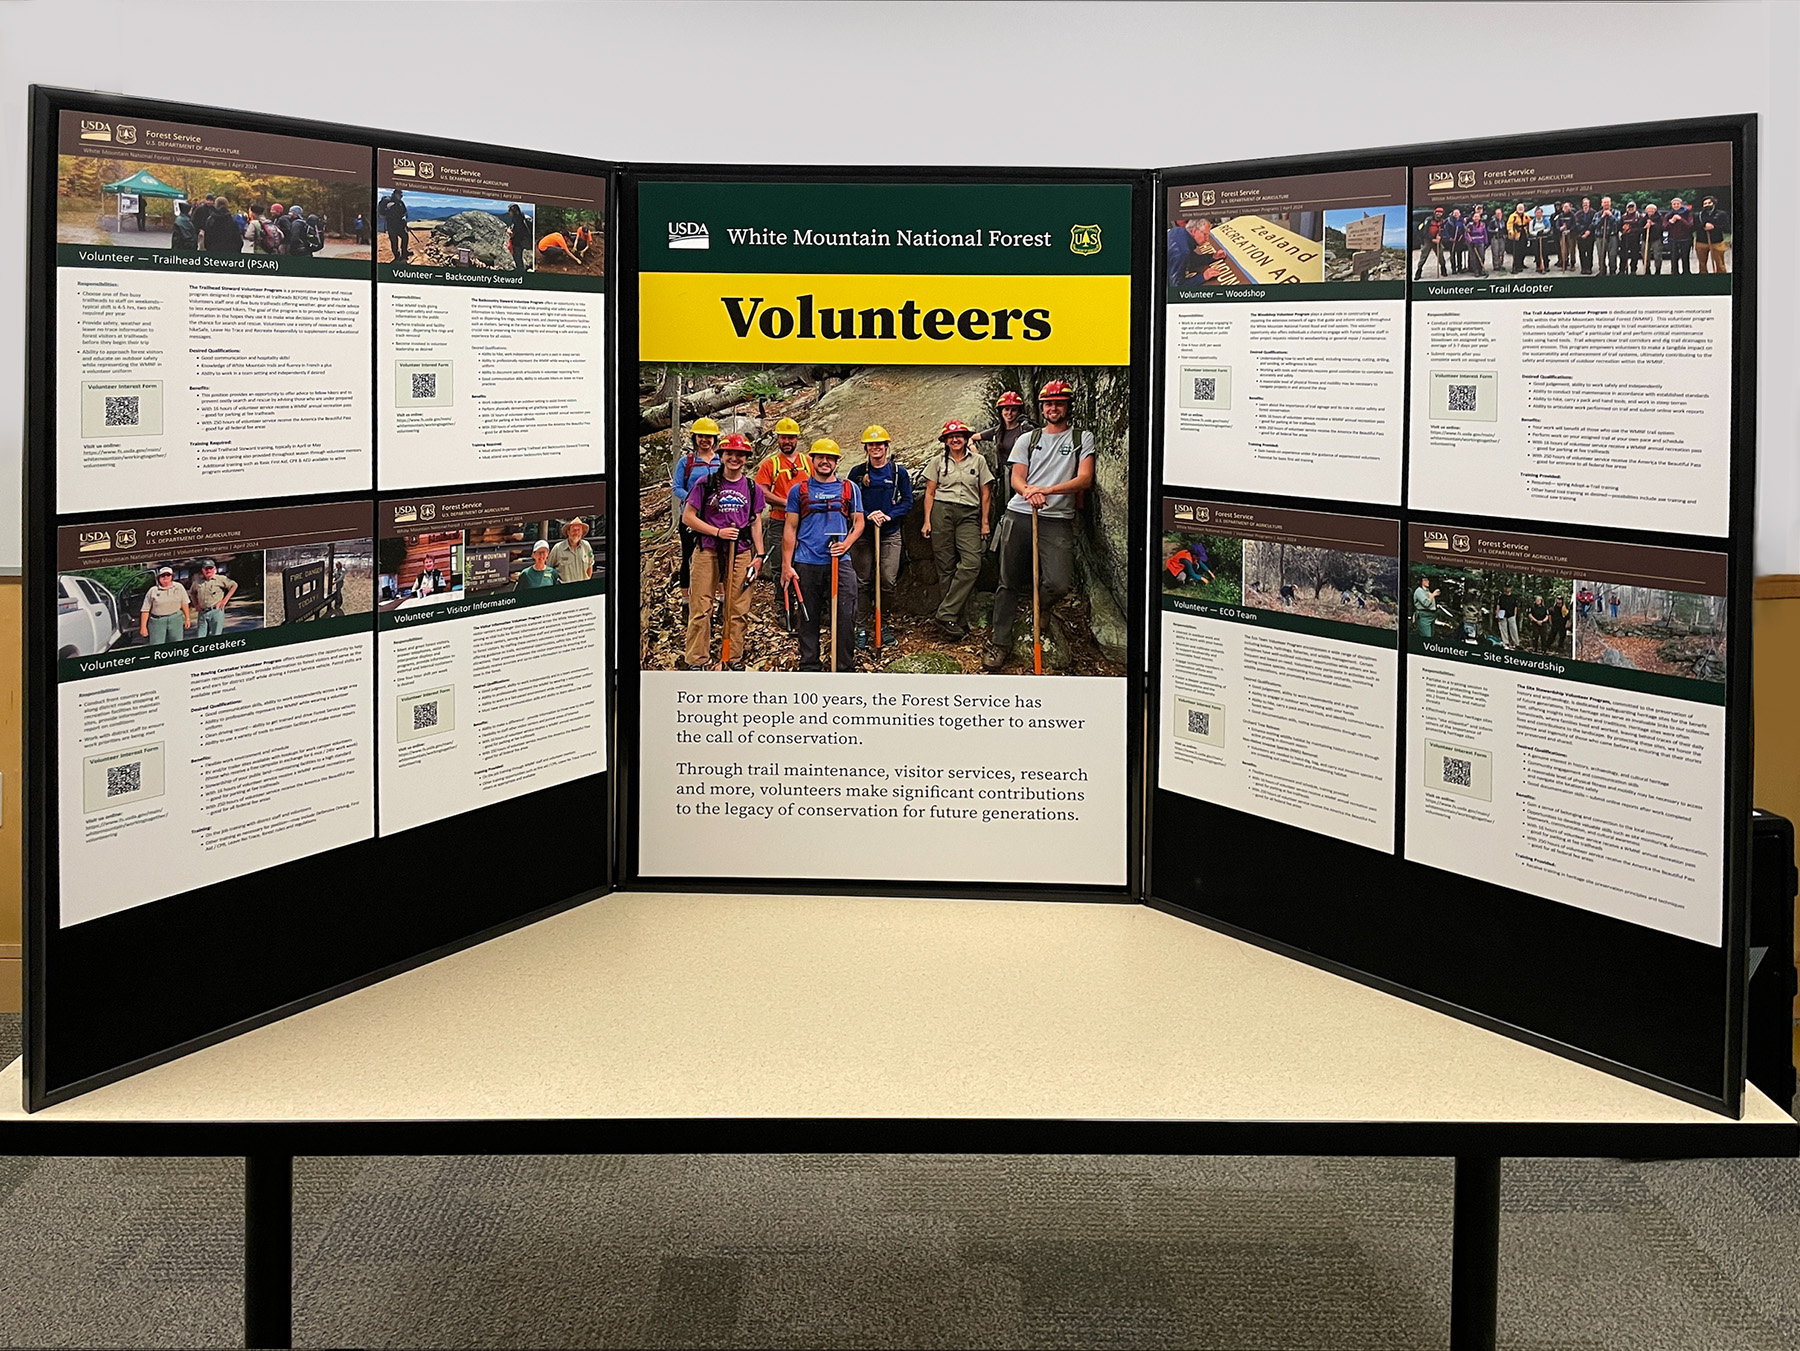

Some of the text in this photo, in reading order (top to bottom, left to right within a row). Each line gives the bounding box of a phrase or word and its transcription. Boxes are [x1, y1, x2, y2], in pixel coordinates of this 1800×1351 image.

[81, 120, 111, 131] USDA
[146, 130, 201, 143] Forest Service
[157, 140, 195, 149] DEPARTMENT
[203, 146, 240, 154] AGRICULTURE
[393, 157, 416, 168] USDA
[440, 166, 481, 177] Forest Service
[1429, 172, 1454, 180] USDA
[1483, 168, 1535, 178] Forest Service
[1494, 176, 1529, 184] DEPARTMENT
[1537, 173, 1574, 181] AGRICULTURE
[1180, 191, 1199, 200] USDA
[668, 221, 709, 236] USDA
[726, 227, 1052, 247] White Mountain National Forest
[1218, 224, 1274, 267] RECREATION
[1250, 225, 1319, 263] Zealand
[78, 251, 279, 271] Volunteer Trailhead Steward (PSAR)
[392, 269, 523, 284] Volunteer Backcountry Steward
[1179, 289, 1266, 298] Volunteer Woodshop
[1428, 283, 1553, 295] Volunteer Trail Adopter
[720, 294, 1052, 341] Volunteers
[394, 505, 417, 514] USDA
[1174, 504, 1193, 513] USDA
[1215, 510, 1254, 520] Forest Service
[79, 531, 111, 541] USDA
[146, 526, 202, 537] Forest Service
[158, 535, 195, 543] DEPARTMENT
[204, 530, 241, 539] AGRICULTURE
[1424, 531, 1448, 542] USDA
[1478, 539, 1529, 551] Forest Service
[1488, 549, 1523, 557] DEPARTMENT
[1531, 553, 1568, 562] AGRICULTURE
[394, 597, 516, 623] Volunteer Visitor Information
[1173, 600, 1257, 620] Volunteer ECO Team
[79, 638, 246, 672] Volunteer Roving Caretakers
[1423, 642, 1565, 674] Volunteer Site Stewardship
[677, 690, 1042, 708] For more than 100 years, the Forest Service has
[676, 709, 1086, 730] brought people and communities together to answer
[676, 729, 863, 745] the call of conservation.
[89, 754, 119, 764] Volunteer
[120, 749, 143, 758] Interest
[675, 761, 1088, 783] Through trail maintenance, visitor services, research
[676, 781, 1085, 801] and more, volunteers make significant contributions
[676, 801, 1079, 822] to the legacy of conservation for future generations.
